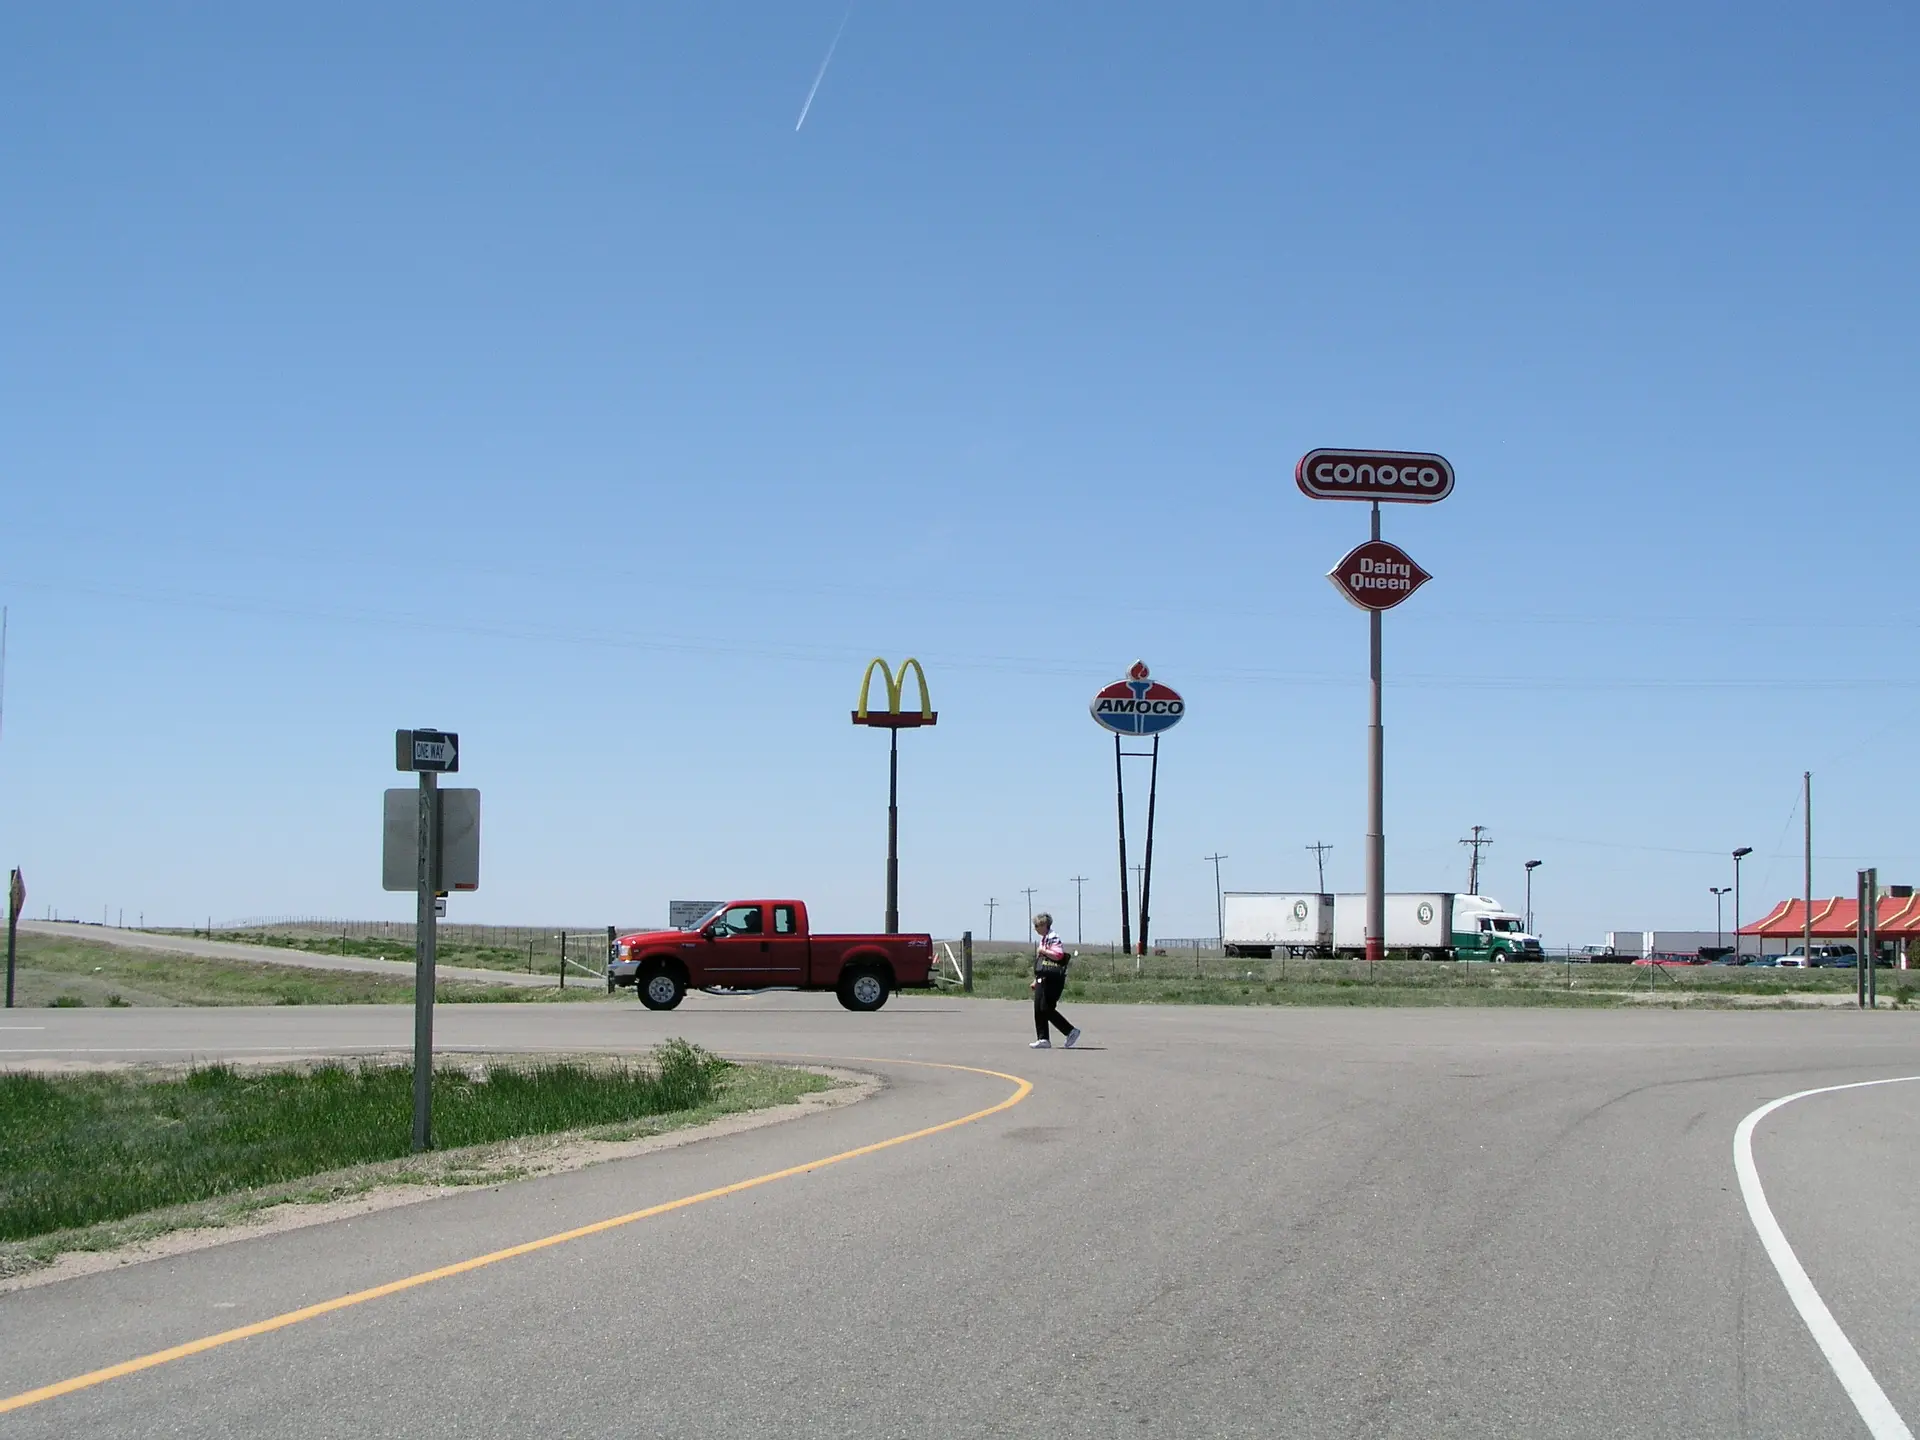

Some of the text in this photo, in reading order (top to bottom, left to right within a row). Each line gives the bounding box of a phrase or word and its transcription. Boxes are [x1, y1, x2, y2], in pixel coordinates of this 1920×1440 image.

[1360, 558, 1410, 578] Dairy
[1350, 573, 1410, 591] Queen
[1096, 699, 1183, 714] AMOCO
[416, 743, 445, 759] ONE WAY
